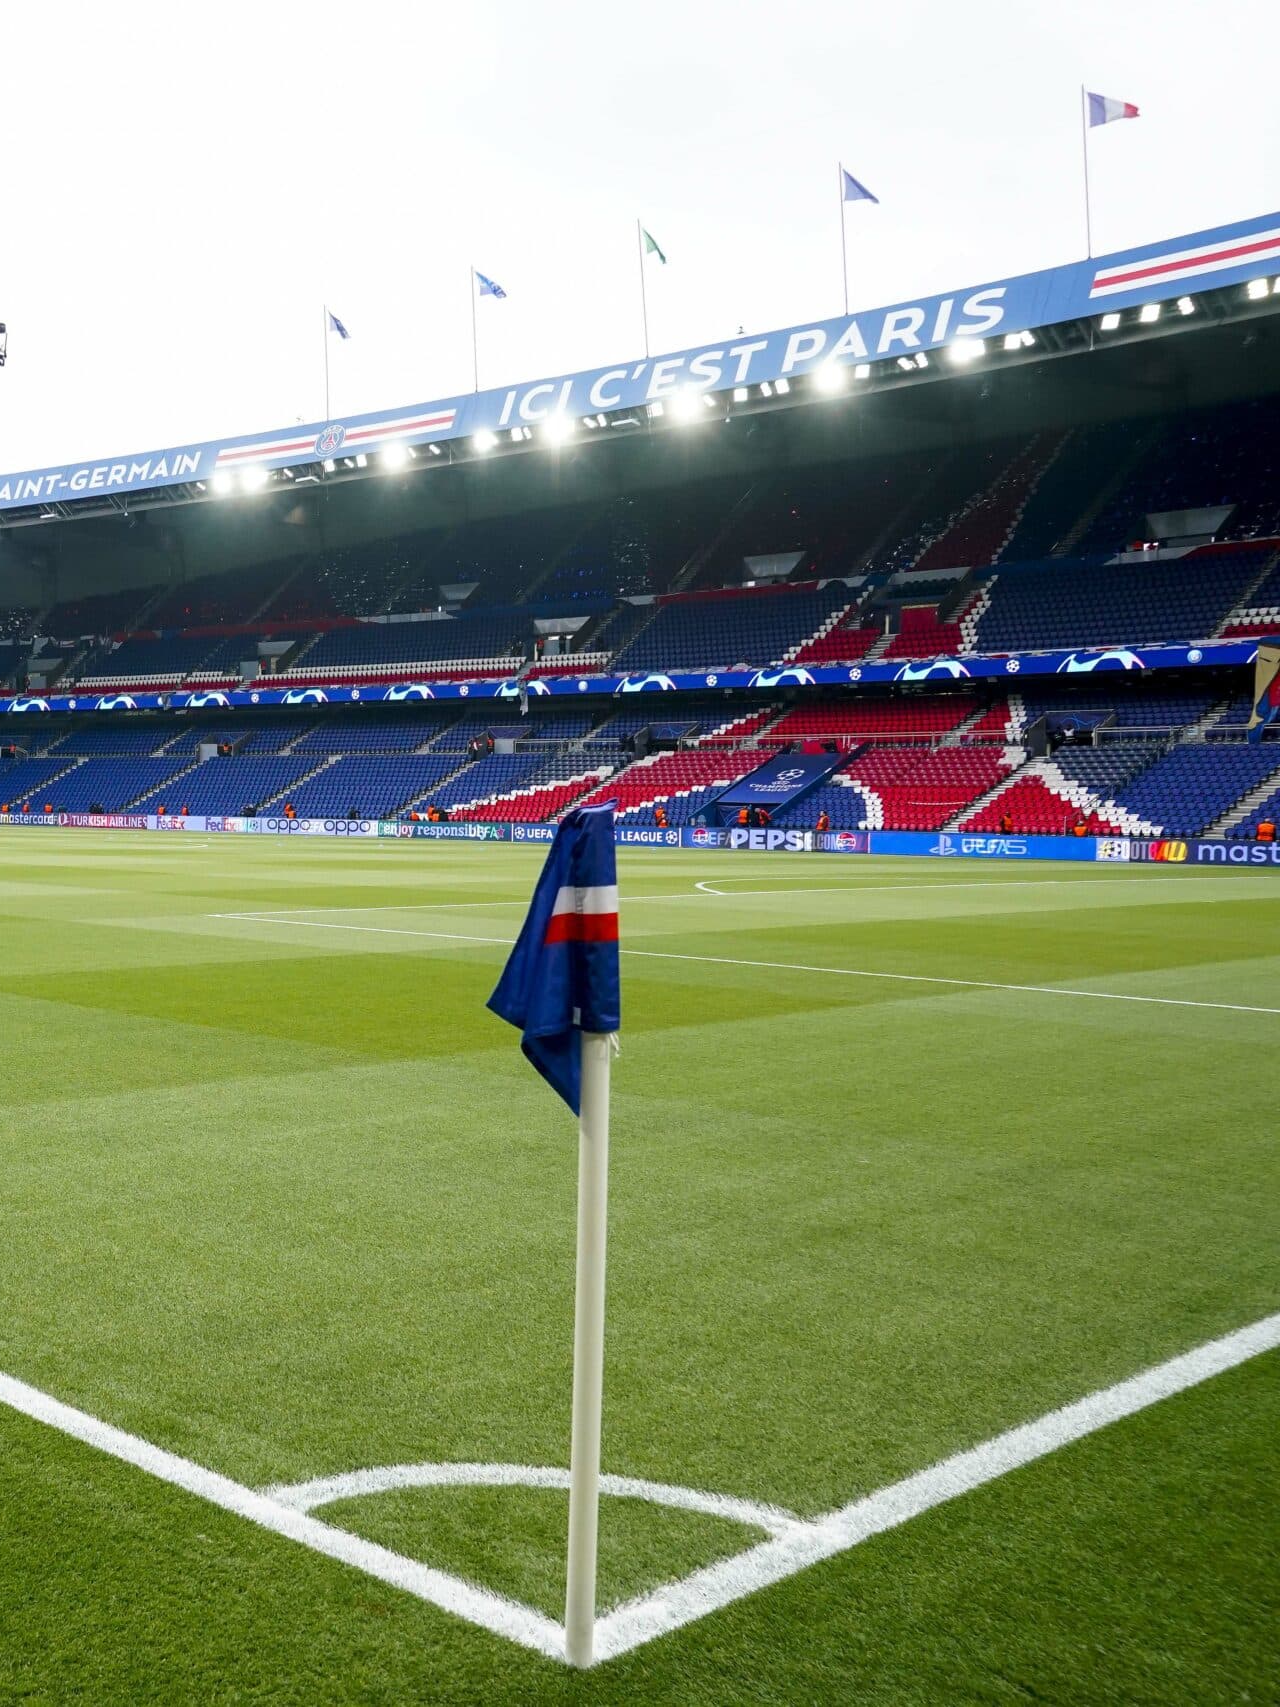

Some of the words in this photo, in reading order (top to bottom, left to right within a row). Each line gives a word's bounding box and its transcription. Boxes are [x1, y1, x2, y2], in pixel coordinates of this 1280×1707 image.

[499, 380, 573, 425] ICI
[590, 341, 768, 407] C'EST
[782, 287, 1007, 373] PARIS
[0, 813, 54, 825] mastercard
[72, 815, 107, 827] TURKISH
[109, 816, 147, 828] AIRLINES
[156, 816, 185, 830] FedEx
[267, 819, 311, 834] oppo
[324, 820, 371, 836] oppo
[527, 828, 553, 839] UEFA
[621, 831, 663, 842] LEAGUE
[731, 827, 813, 852] PEPSI
